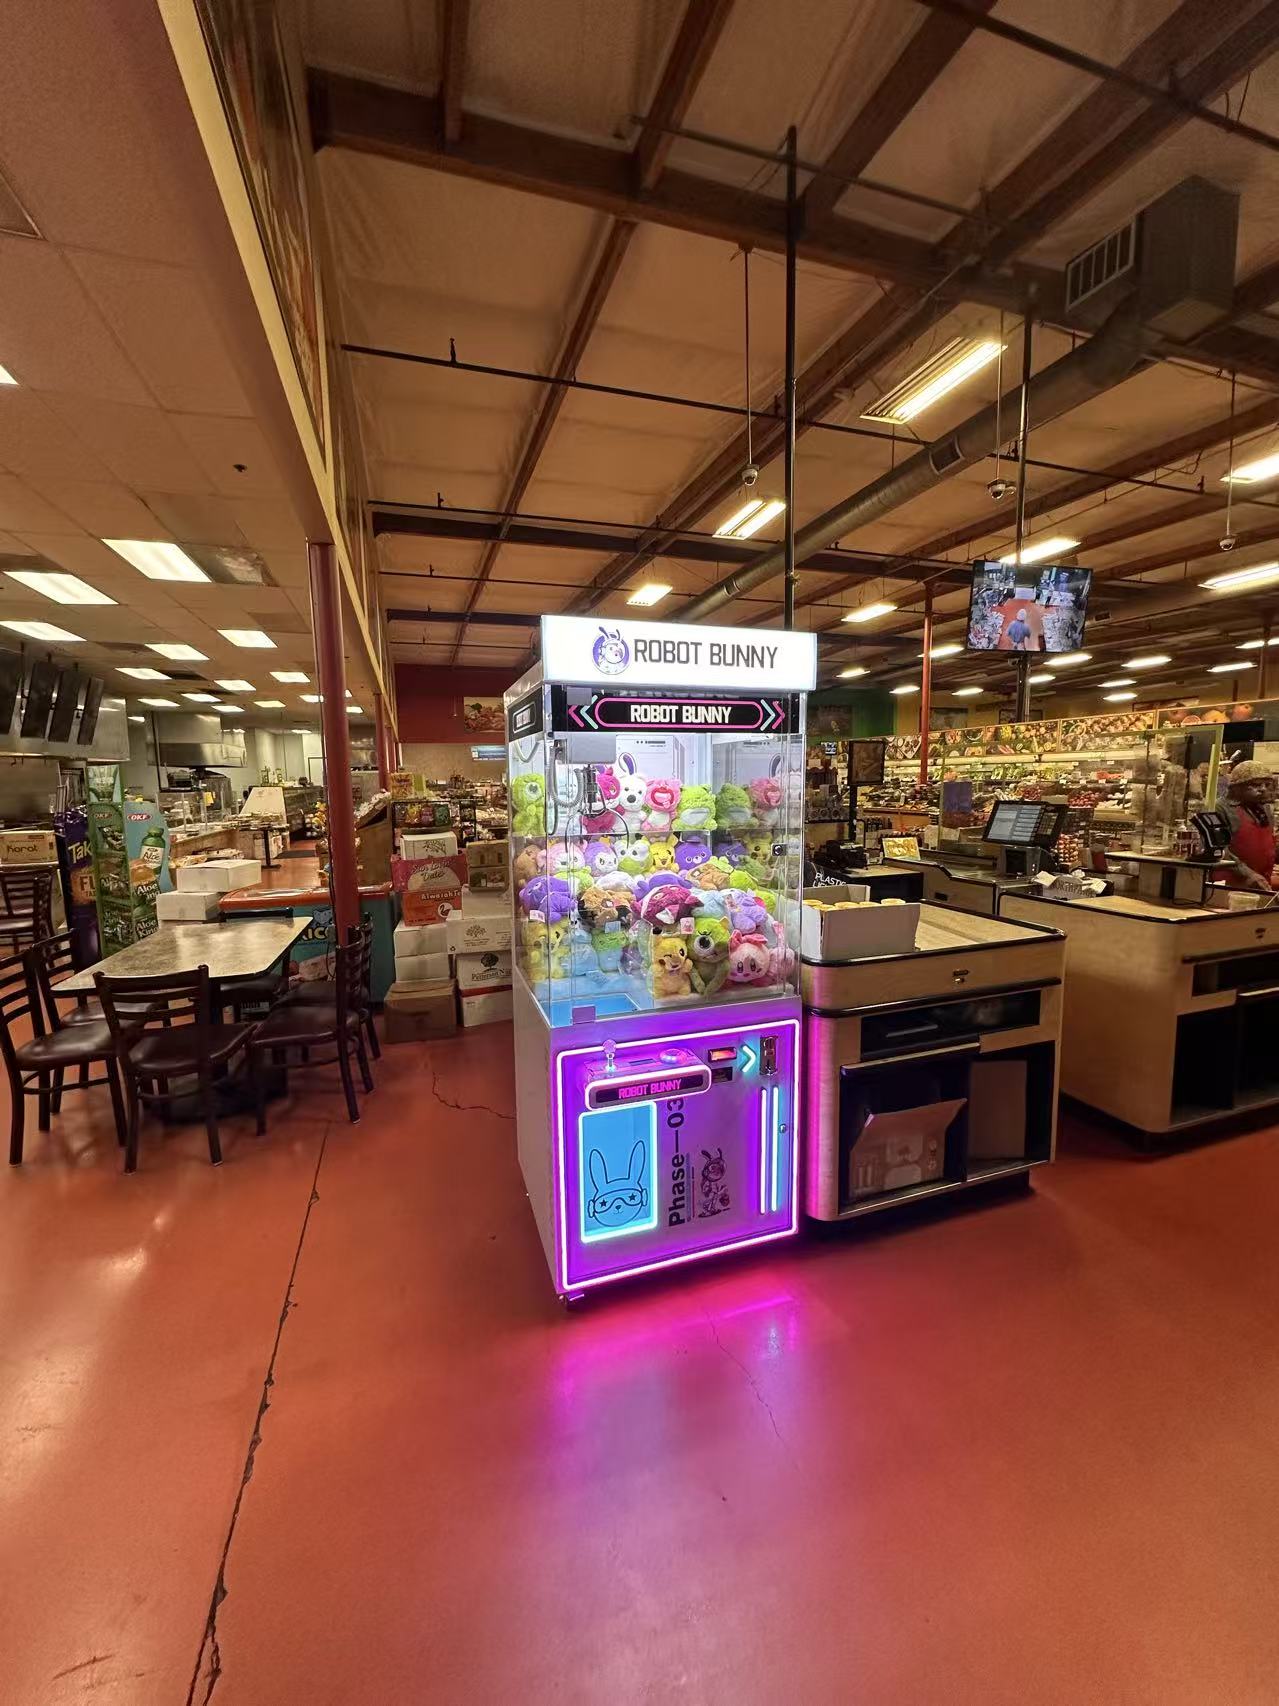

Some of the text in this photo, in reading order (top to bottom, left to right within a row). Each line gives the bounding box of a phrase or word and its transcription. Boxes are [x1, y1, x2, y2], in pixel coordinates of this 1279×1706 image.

[634, 639, 778, 669] ROBOT BUNNY
[630, 704, 732, 724] ROBOT BUNNY
[136, 882, 159, 895] Aloe
[136, 919, 157, 931] Aloe
[619, 1079, 681, 1099] ROBOT BUNNY
